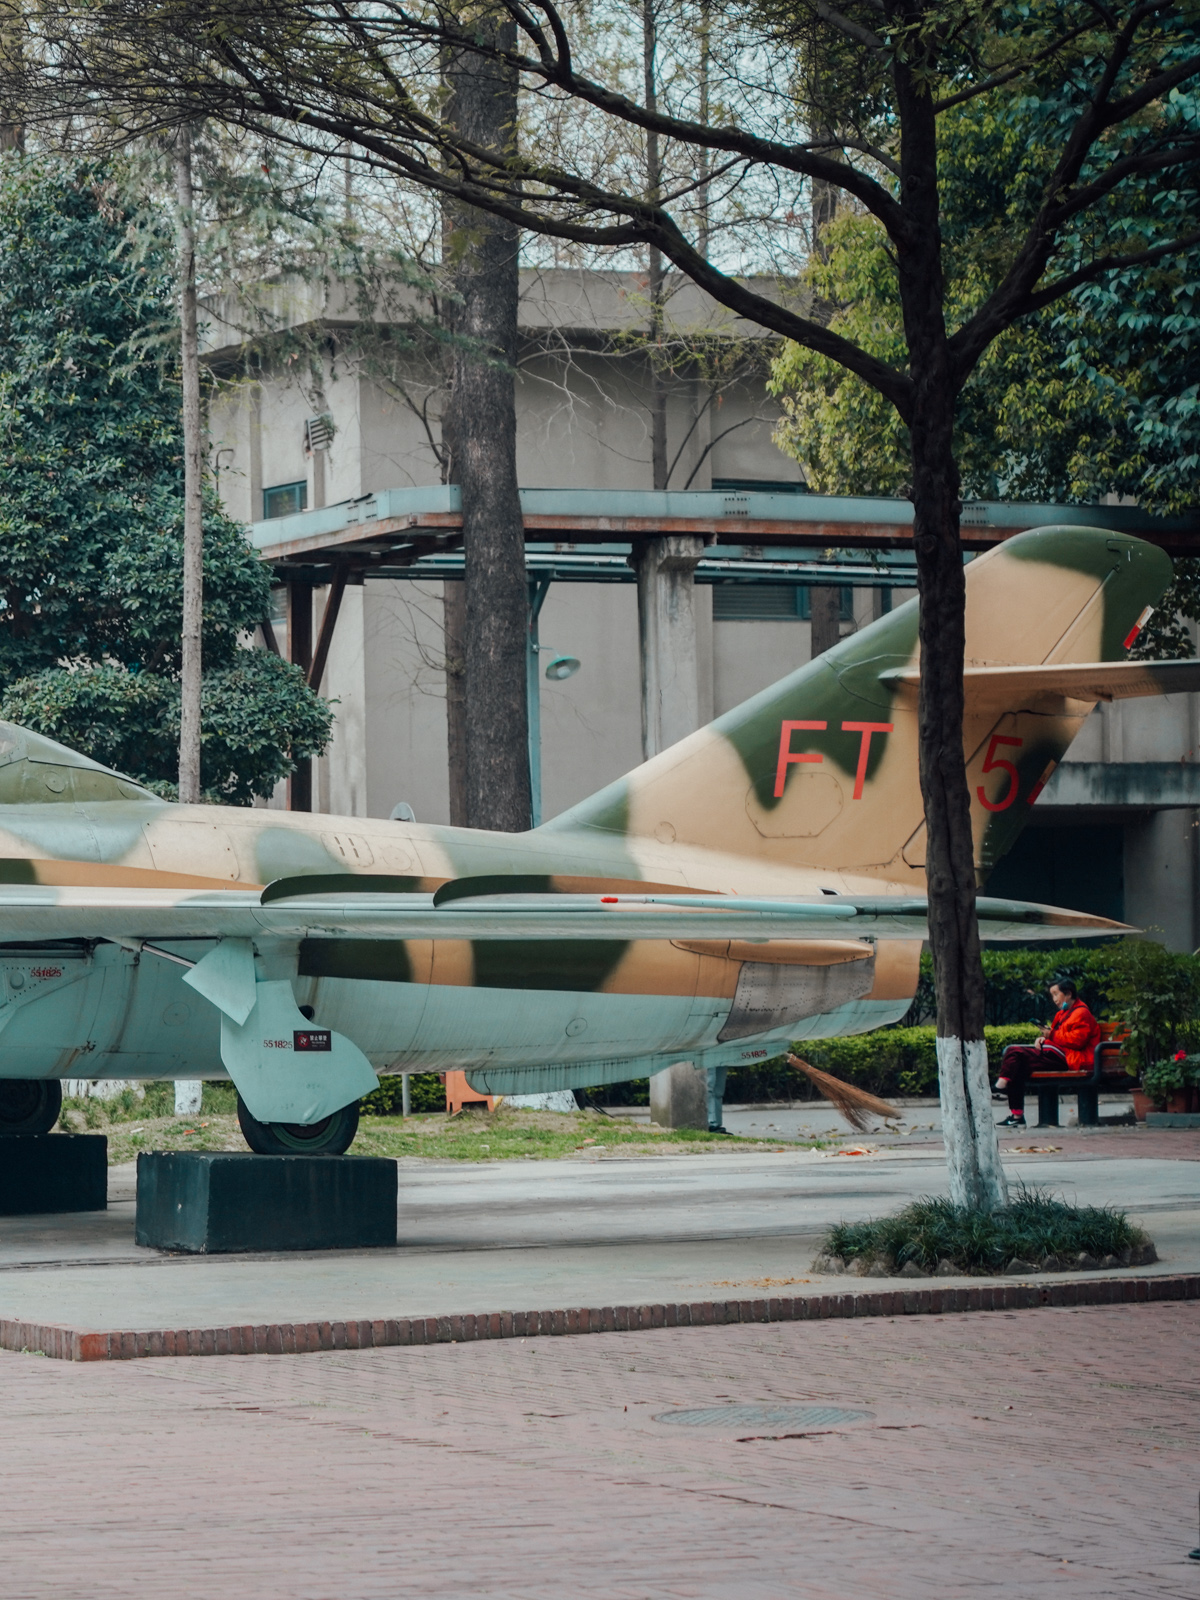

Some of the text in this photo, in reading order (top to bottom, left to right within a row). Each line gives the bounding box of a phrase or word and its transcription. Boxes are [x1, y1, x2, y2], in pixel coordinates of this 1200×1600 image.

[30, 969, 62, 978] 551825
[263, 1039, 293, 1049] 551825
[741, 1049, 768, 1060] 551825
